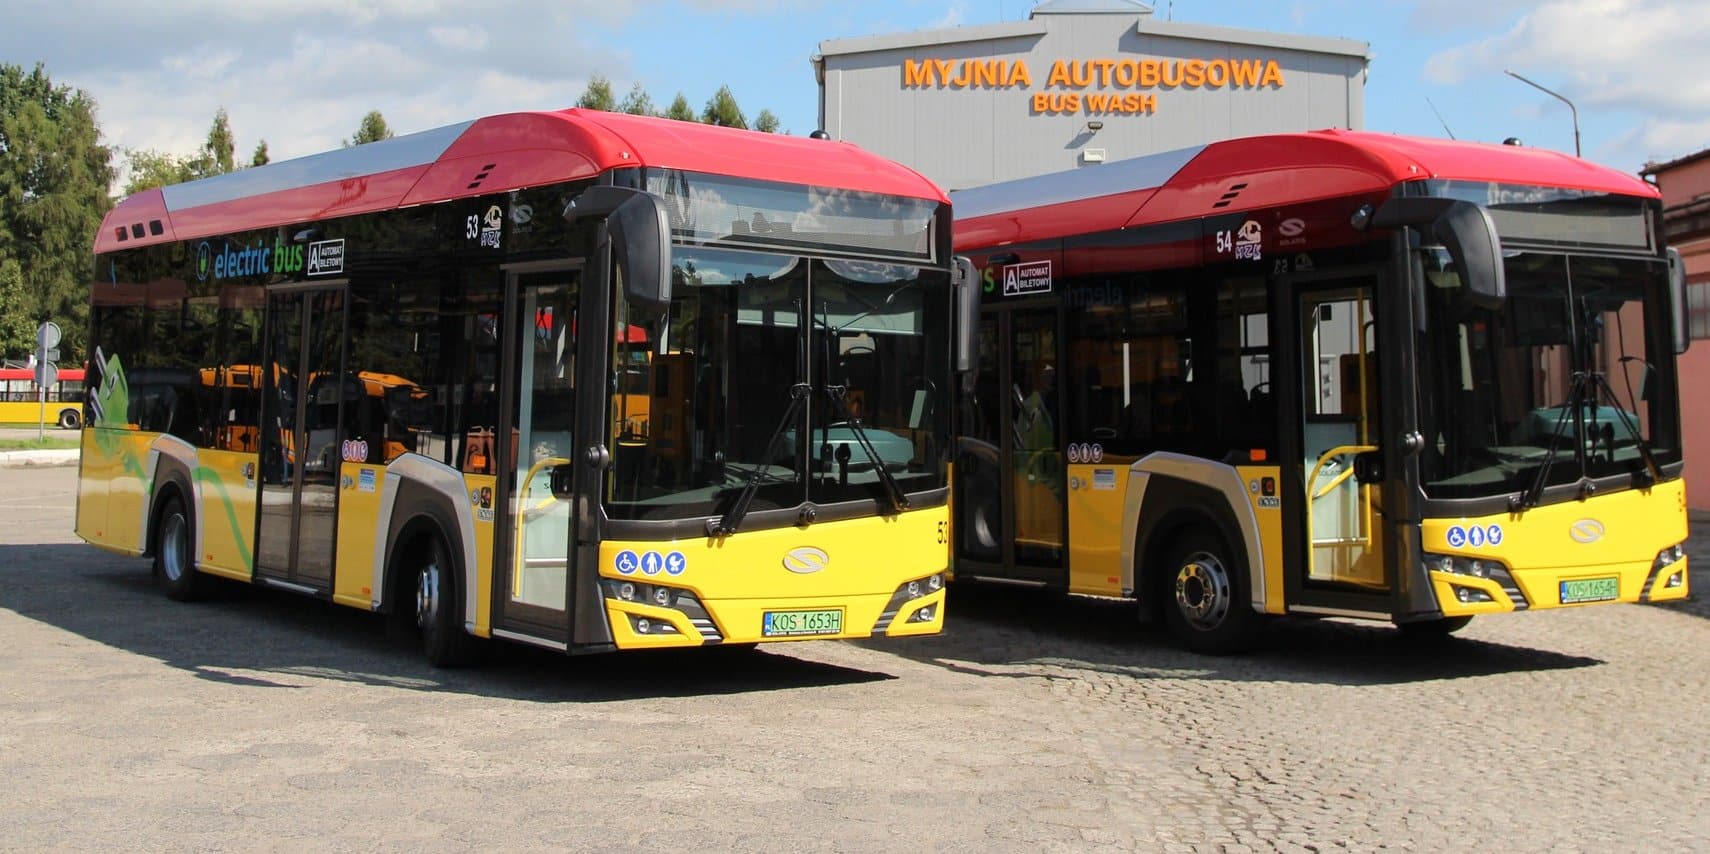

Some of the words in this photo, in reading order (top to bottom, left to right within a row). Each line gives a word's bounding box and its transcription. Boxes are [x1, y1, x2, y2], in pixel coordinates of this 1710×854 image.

[904, 58, 1032, 87] MYJNIA
[1049, 58, 1284, 88] AUTOBUSOWA
[1033, 91, 1081, 113] BUS
[1086, 92, 1158, 113] WASH
[466, 214, 479, 239] 53
[1216, 229, 1233, 253] 54
[214, 239, 271, 279] electric
[273, 237, 304, 273] bus
[309, 246, 319, 270] A
[1006, 269, 1018, 291] A
[1019, 278, 1050, 289] BILETOWY
[1020, 266, 1049, 278] AUTOMAT
[937, 520, 948, 544] 53
[771, 613, 798, 631] KOS
[802, 612, 840, 630] 1653H
